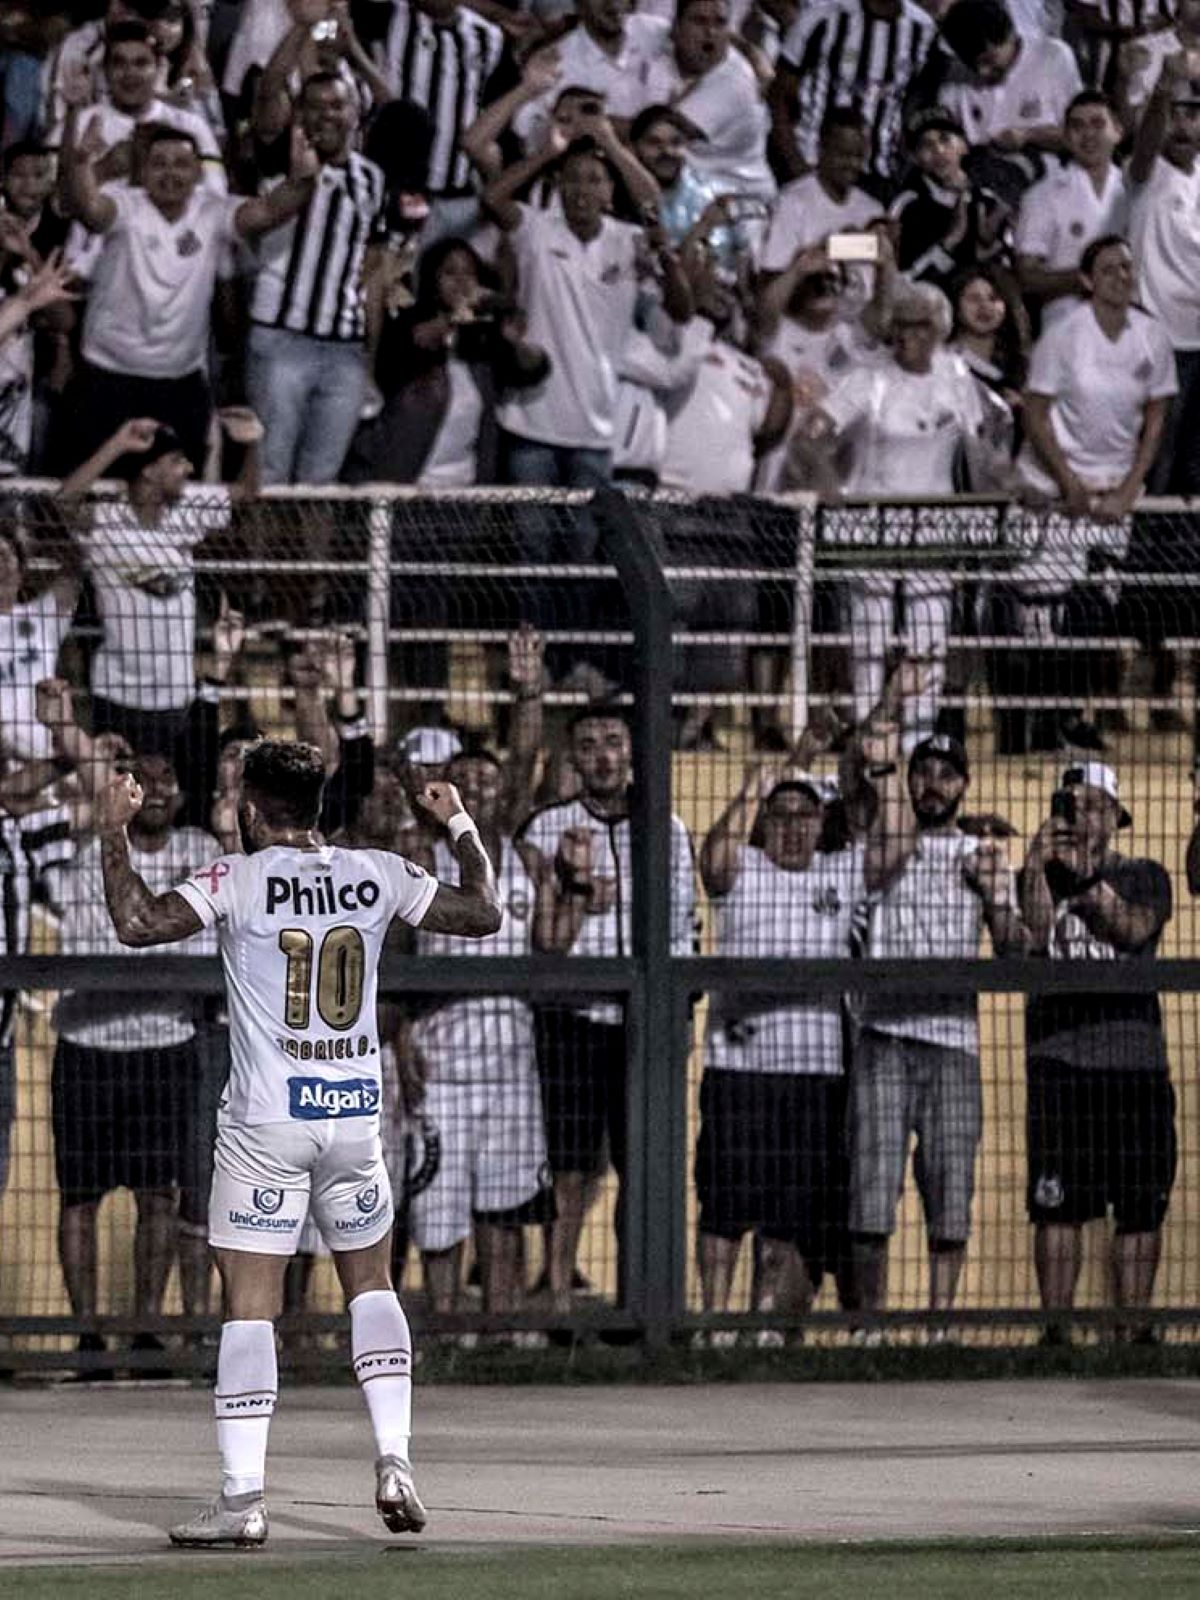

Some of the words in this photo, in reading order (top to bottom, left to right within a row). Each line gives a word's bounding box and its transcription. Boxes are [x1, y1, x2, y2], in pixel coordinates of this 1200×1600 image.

[265, 876, 380, 916] Philco
[279, 925, 366, 1031] 10
[299, 1082, 362, 1116] Algar
[229, 1209, 300, 1229] UniCesumar
[335, 1200, 388, 1230] UniCes
[226, 1398, 276, 1410] SANT
